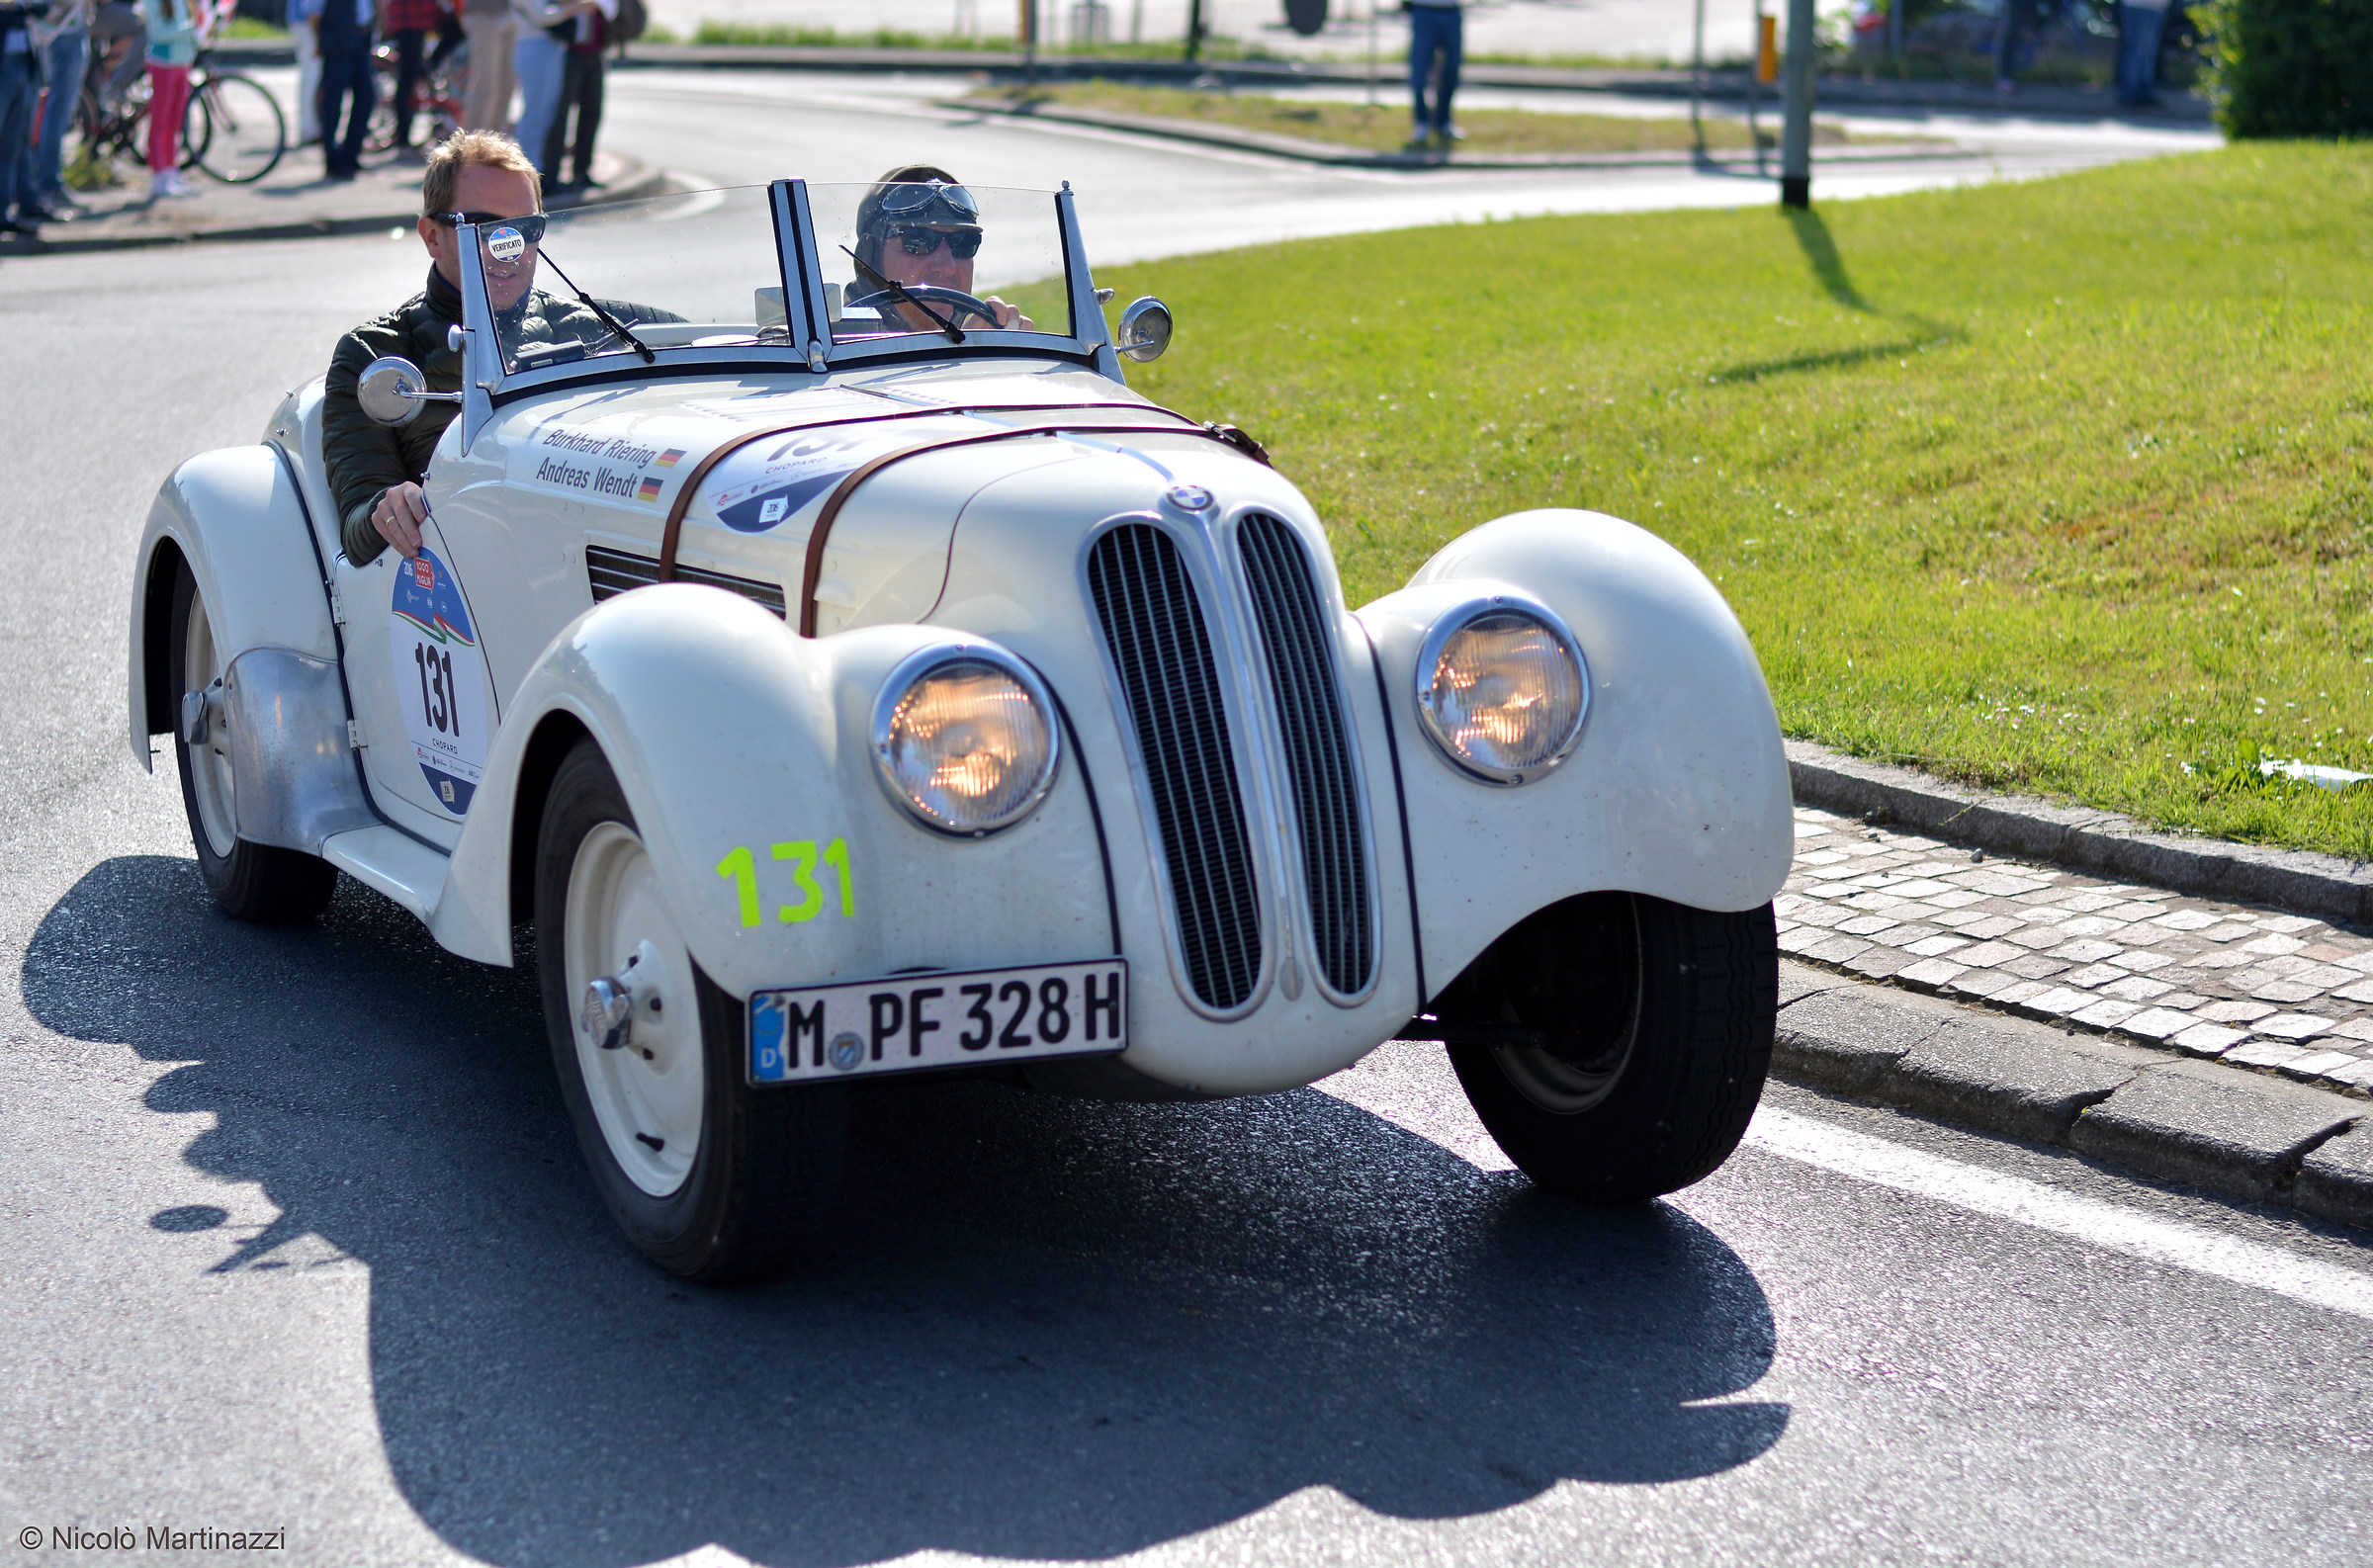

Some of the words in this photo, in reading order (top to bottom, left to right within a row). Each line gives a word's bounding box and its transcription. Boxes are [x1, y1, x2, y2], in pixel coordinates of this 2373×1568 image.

[491, 239, 521, 252] VERIFICATO
[543, 429, 612, 455] Burkhard
[603, 439, 657, 470] Riering
[536, 457, 590, 488] Andreas
[593, 467, 638, 498] Wendt
[765, 457, 828, 475] CHOPARD
[416, 562, 430, 573] 1000
[415, 642, 459, 738] 131
[432, 738, 458, 754] CHOPARD
[715, 836, 855, 927] 131
[788, 1000, 825, 1069] M
[869, 988, 944, 1061] PF
[760, 1048, 777, 1069] D
